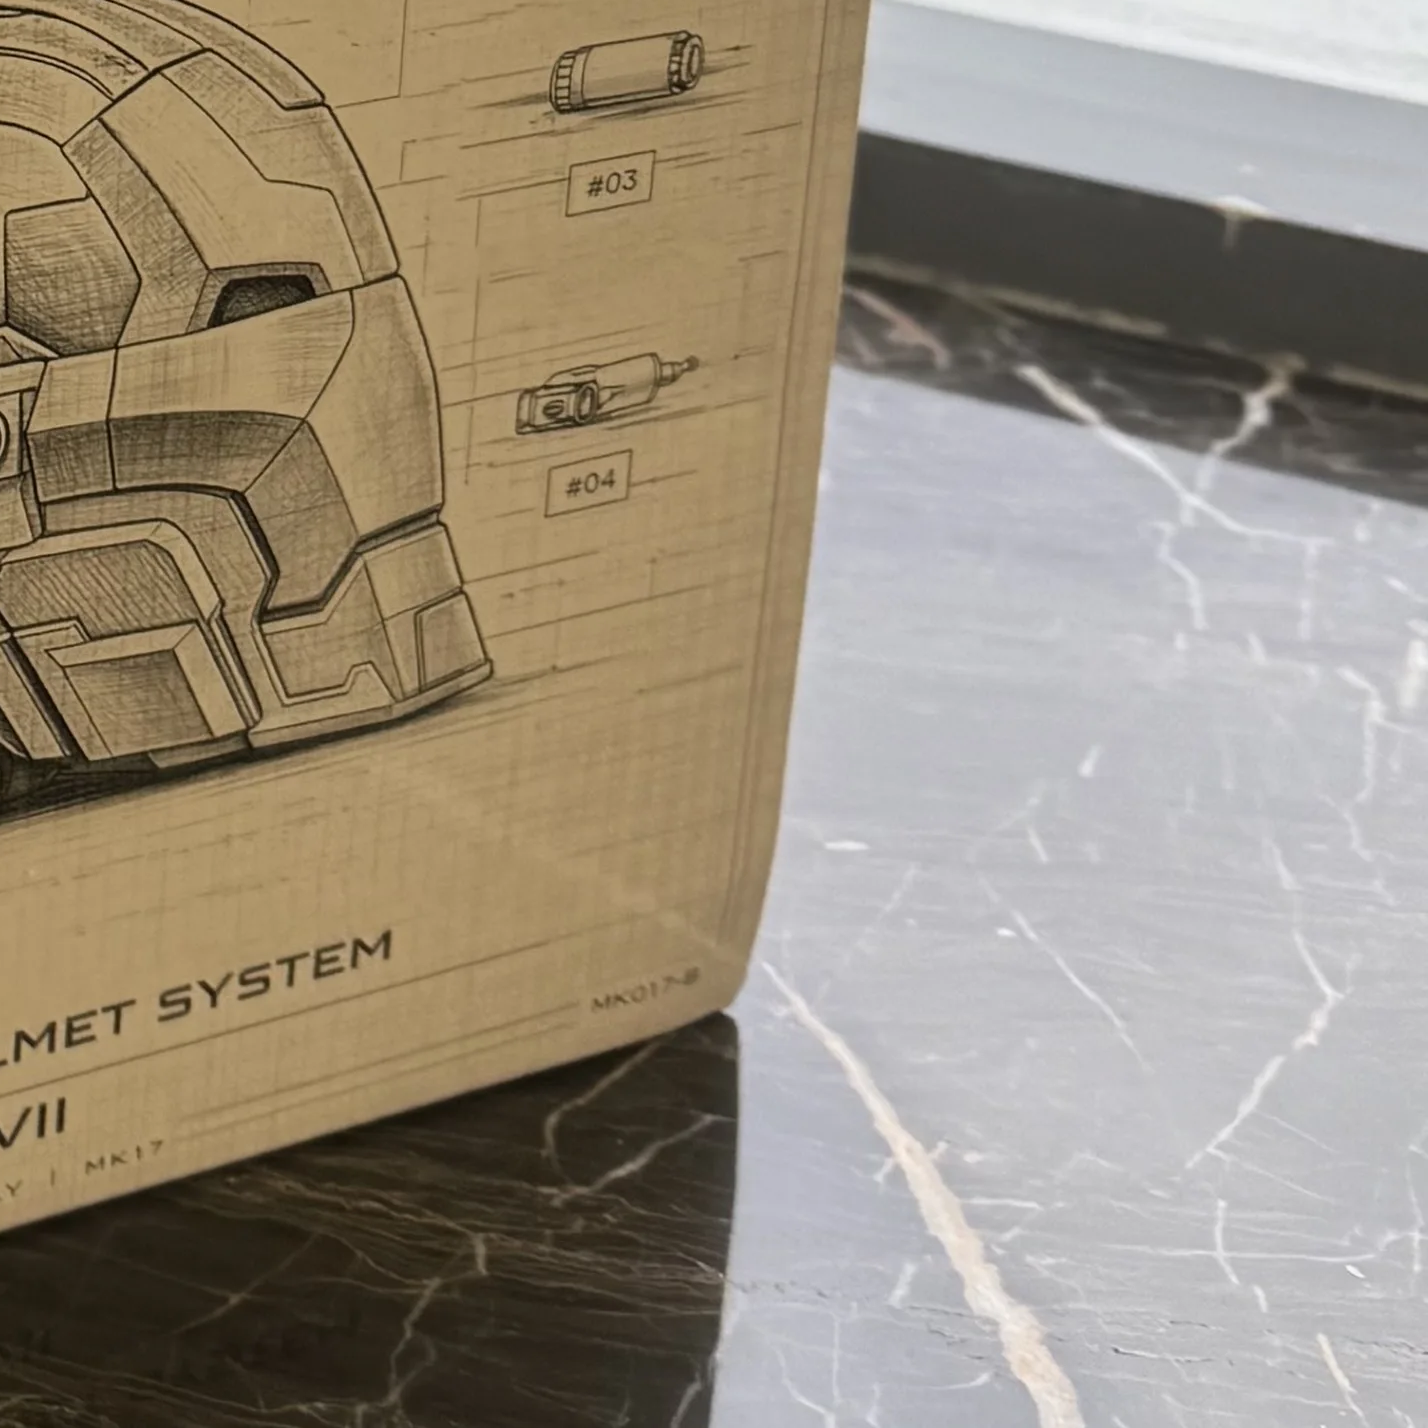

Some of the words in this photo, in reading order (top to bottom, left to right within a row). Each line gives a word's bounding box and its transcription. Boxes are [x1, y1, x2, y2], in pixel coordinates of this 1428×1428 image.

[587, 169, 638, 198] #03
[566, 469, 617, 496] #04
[157, 929, 392, 1023] SYSTEM
[84, 1139, 165, 1175] MK17
